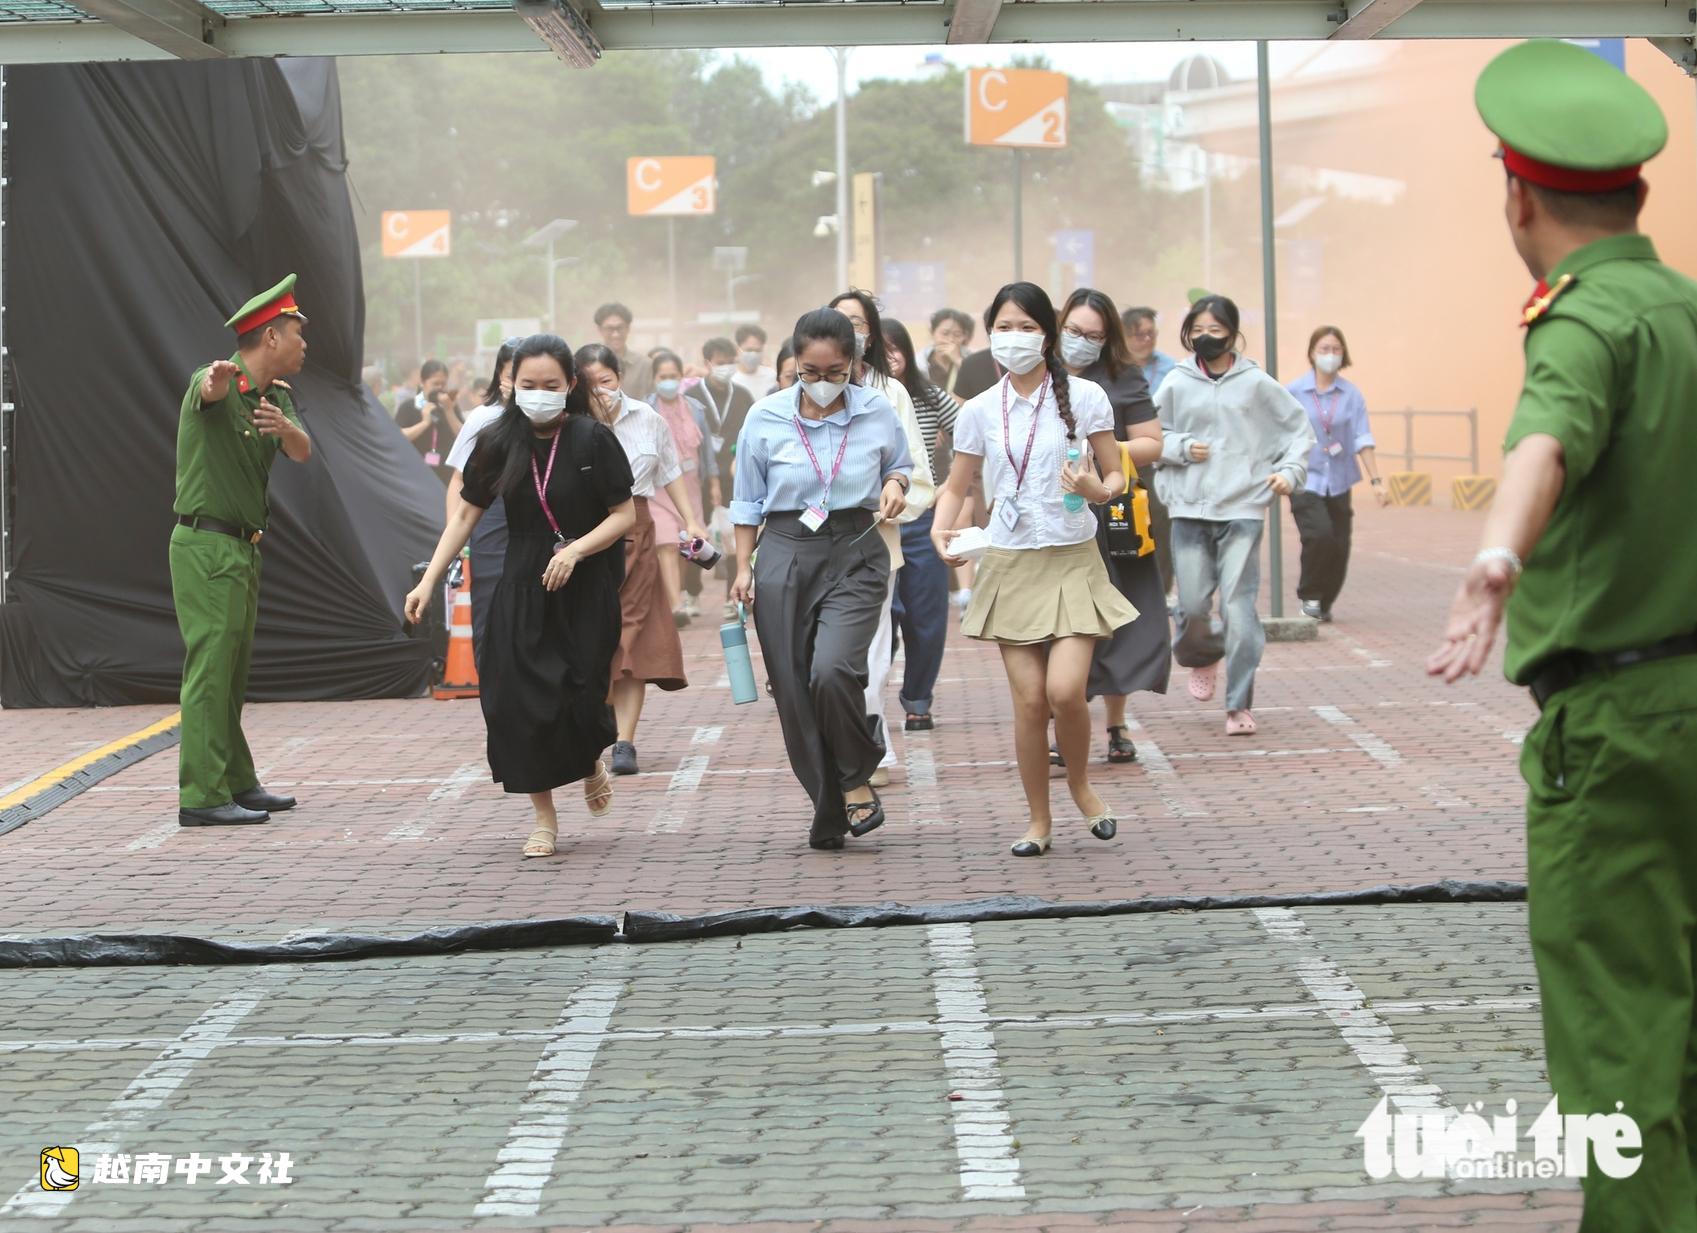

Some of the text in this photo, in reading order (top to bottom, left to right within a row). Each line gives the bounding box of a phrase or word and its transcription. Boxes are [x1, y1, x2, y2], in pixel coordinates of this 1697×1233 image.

[978, 70, 1009, 112] C
[1042, 111, 1061, 142] 2
[635, 158, 662, 191] C
[692, 188, 708, 210] 3
[387, 211, 409, 240] C
[431, 234, 445, 252] 4
